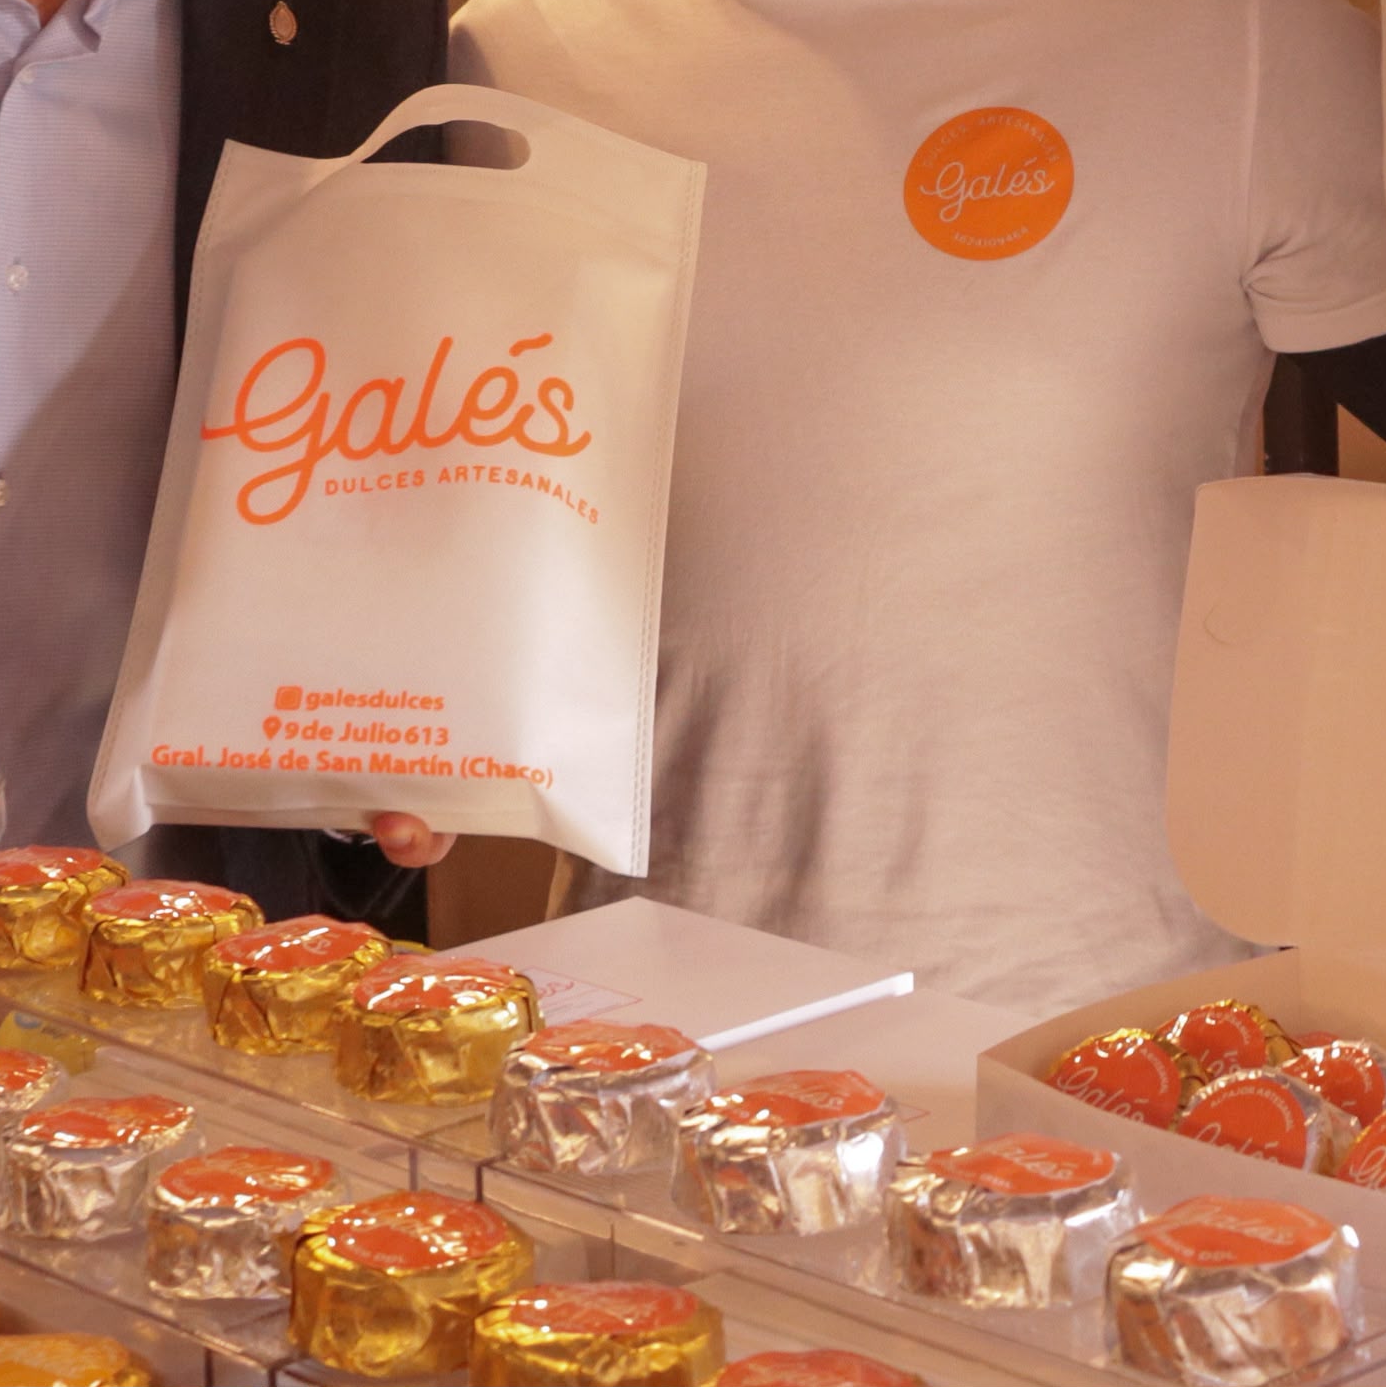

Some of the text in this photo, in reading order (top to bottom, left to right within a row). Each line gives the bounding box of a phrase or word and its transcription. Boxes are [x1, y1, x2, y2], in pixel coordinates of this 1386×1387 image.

[325, 465, 599, 525] DULCES ARTESANALES
[305, 686, 445, 711] galesdulces
[151, 743, 554, 790] Gral. José de San Martín (Chaco)
